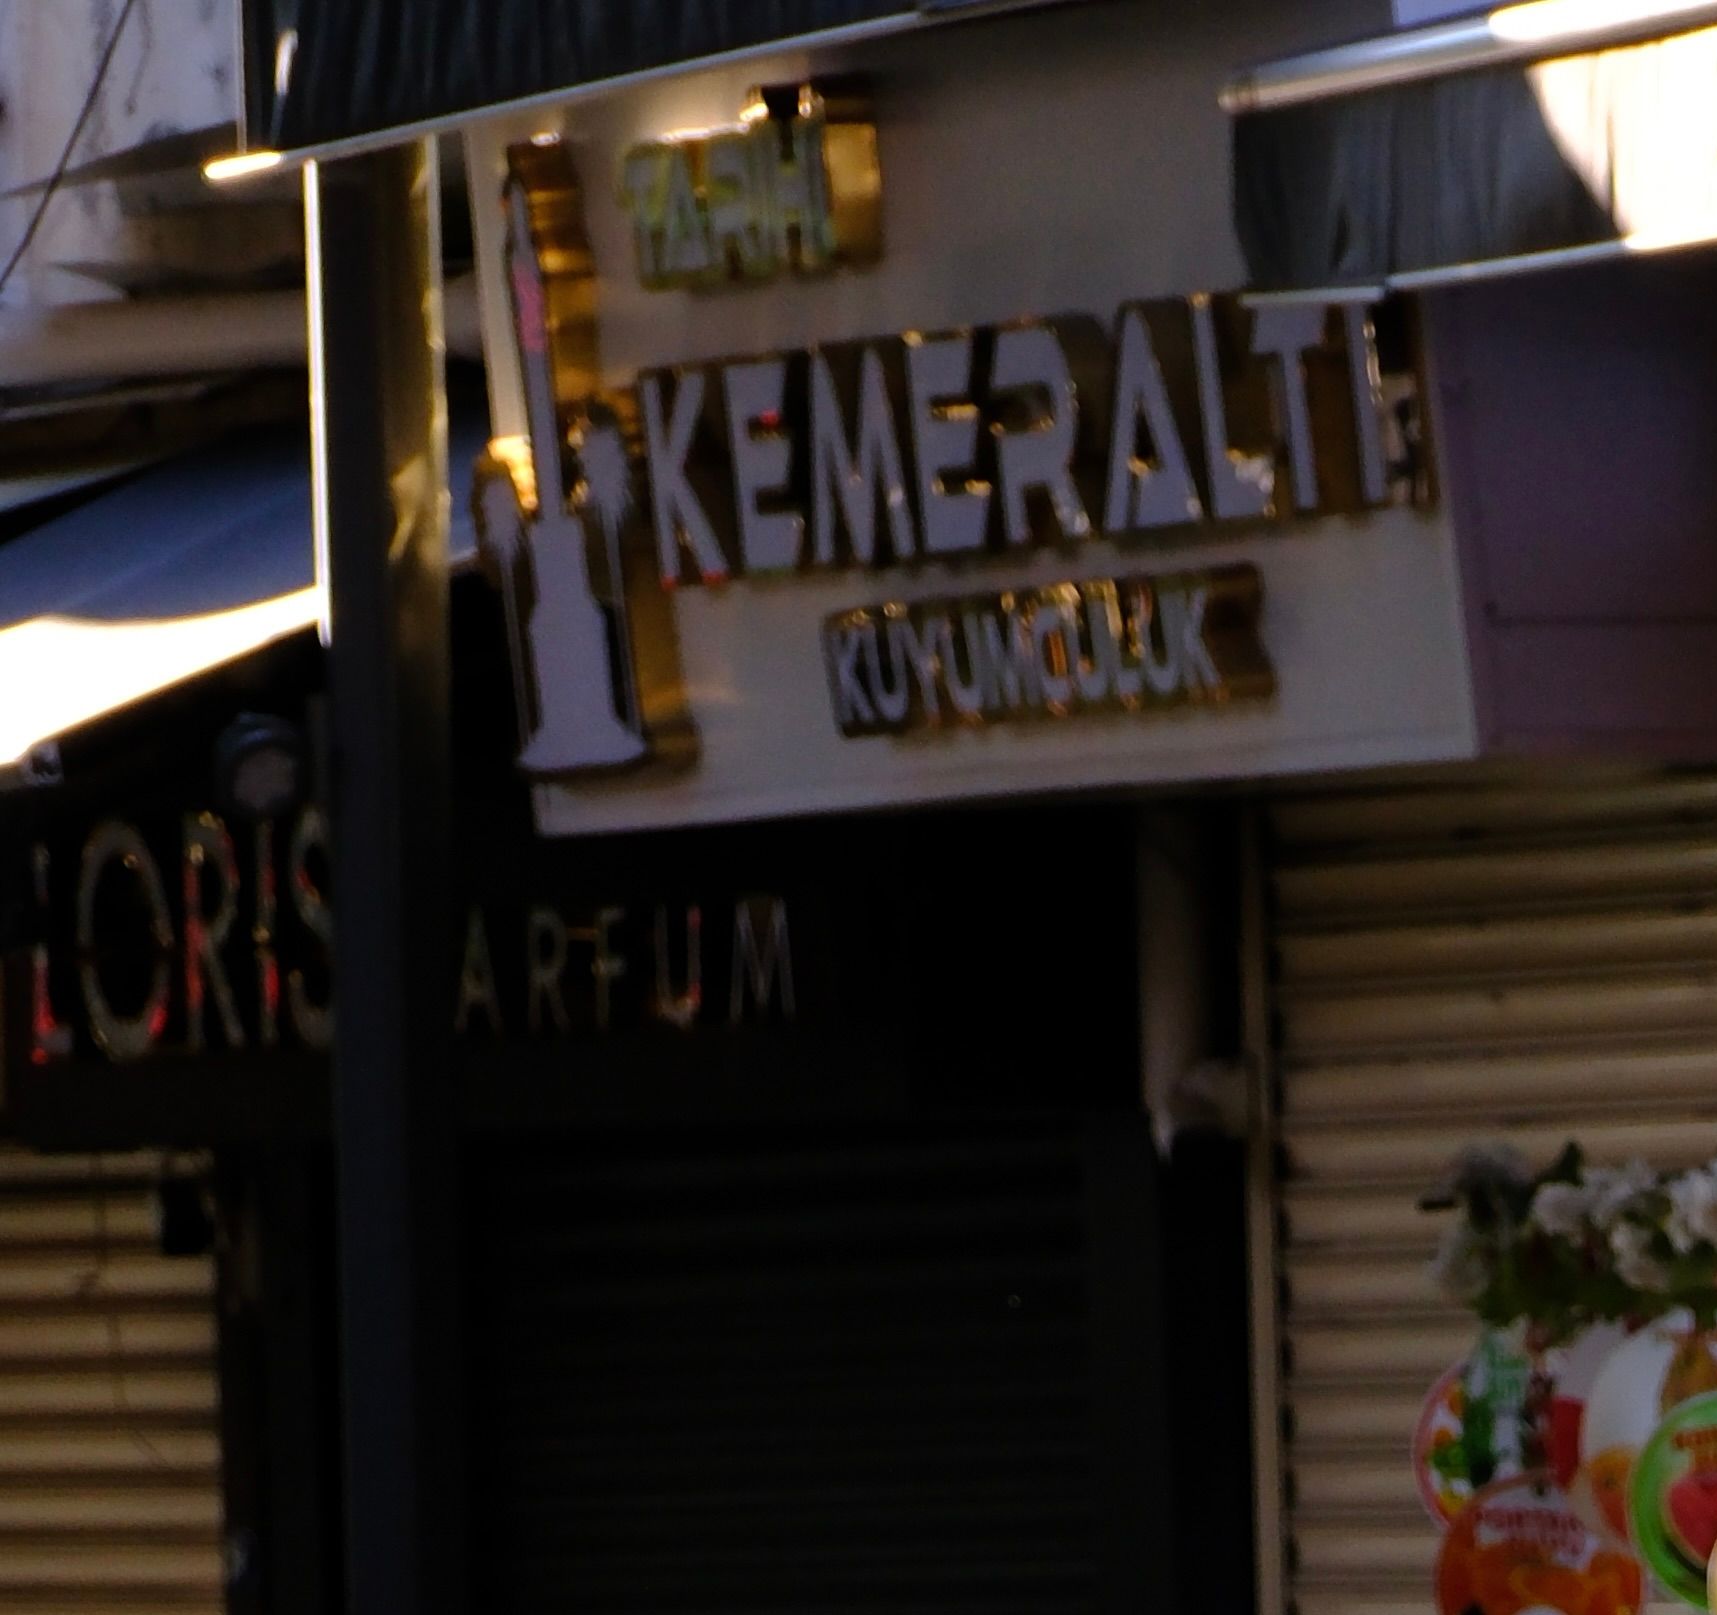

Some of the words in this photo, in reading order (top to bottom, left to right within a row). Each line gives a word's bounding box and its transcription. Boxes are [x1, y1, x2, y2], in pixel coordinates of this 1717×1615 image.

[640, 292, 1392, 590] KEMERALTI
[830, 582, 1224, 726] KUYUMCULUK
[450, 890, 798, 1038] ARFUM
